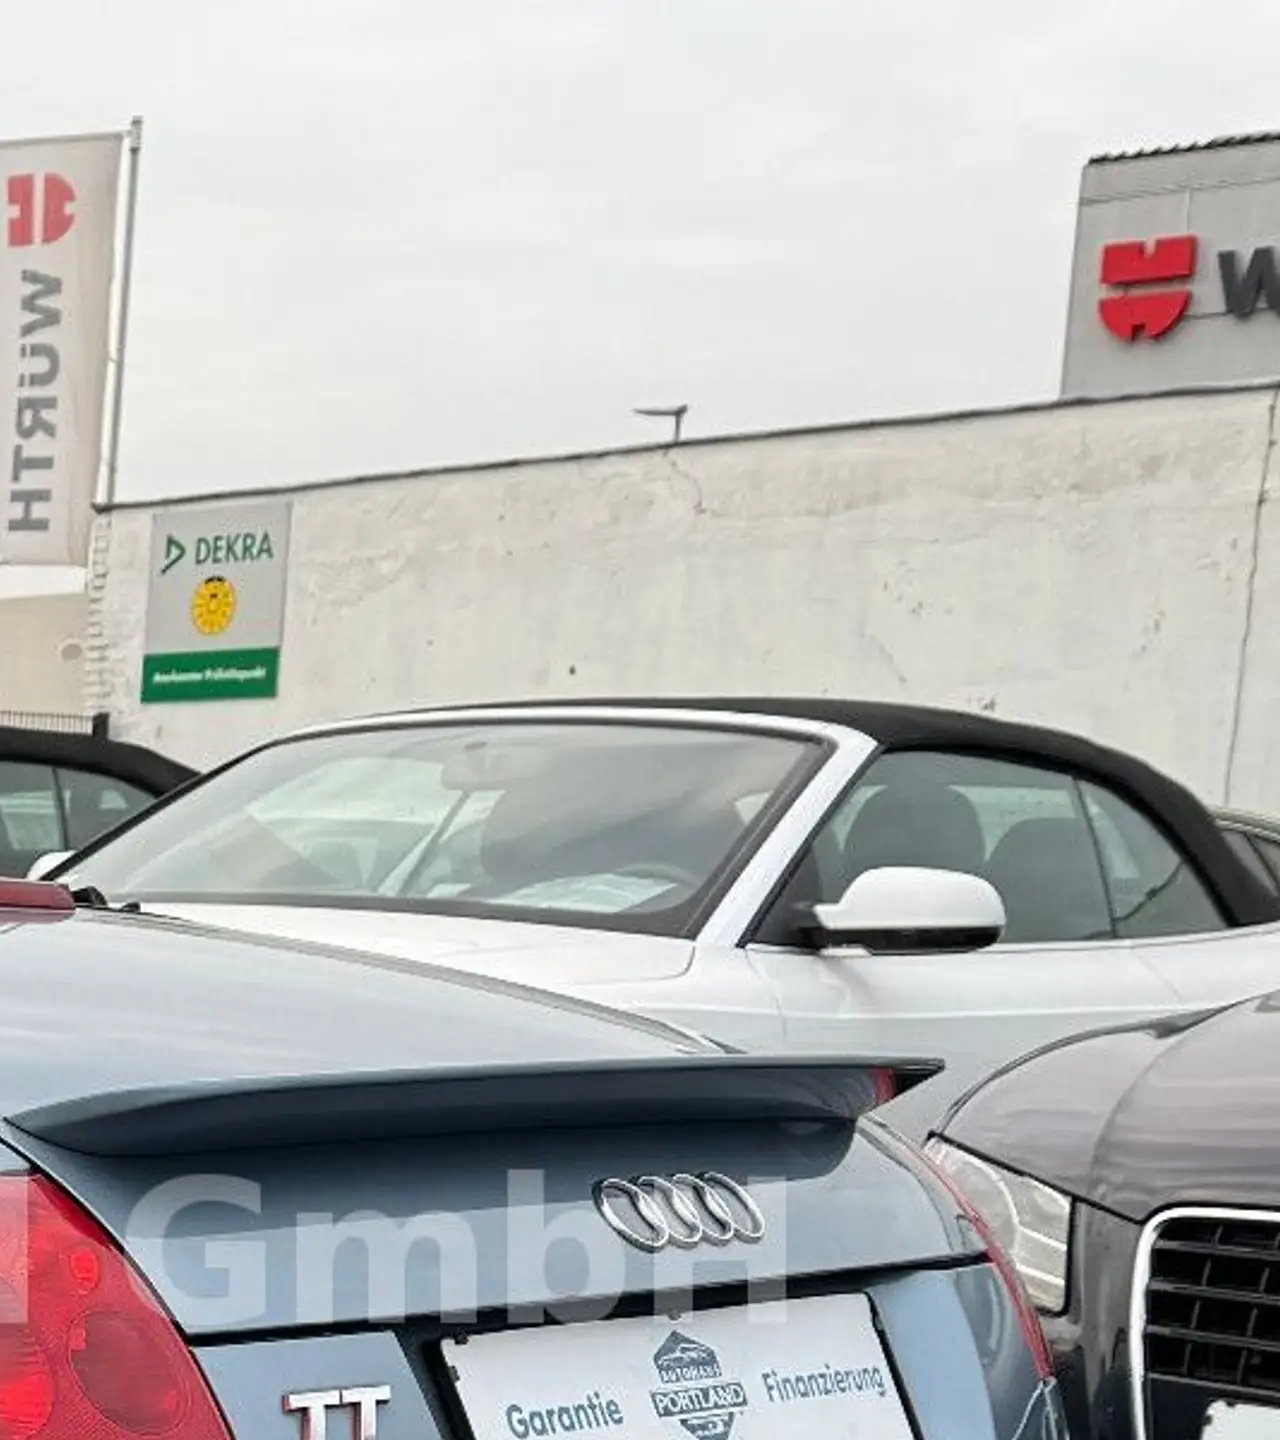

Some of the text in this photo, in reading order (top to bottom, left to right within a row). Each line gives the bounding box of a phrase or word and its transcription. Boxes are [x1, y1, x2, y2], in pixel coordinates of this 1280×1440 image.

[195, 529, 275, 566] DEKRA
[660, 1362, 722, 1384] AUTOHAUS
[761, 1364, 887, 1403] Finanzierung
[506, 1391, 624, 1440] Garantie
[654, 1383, 746, 1415] PORTLAND
